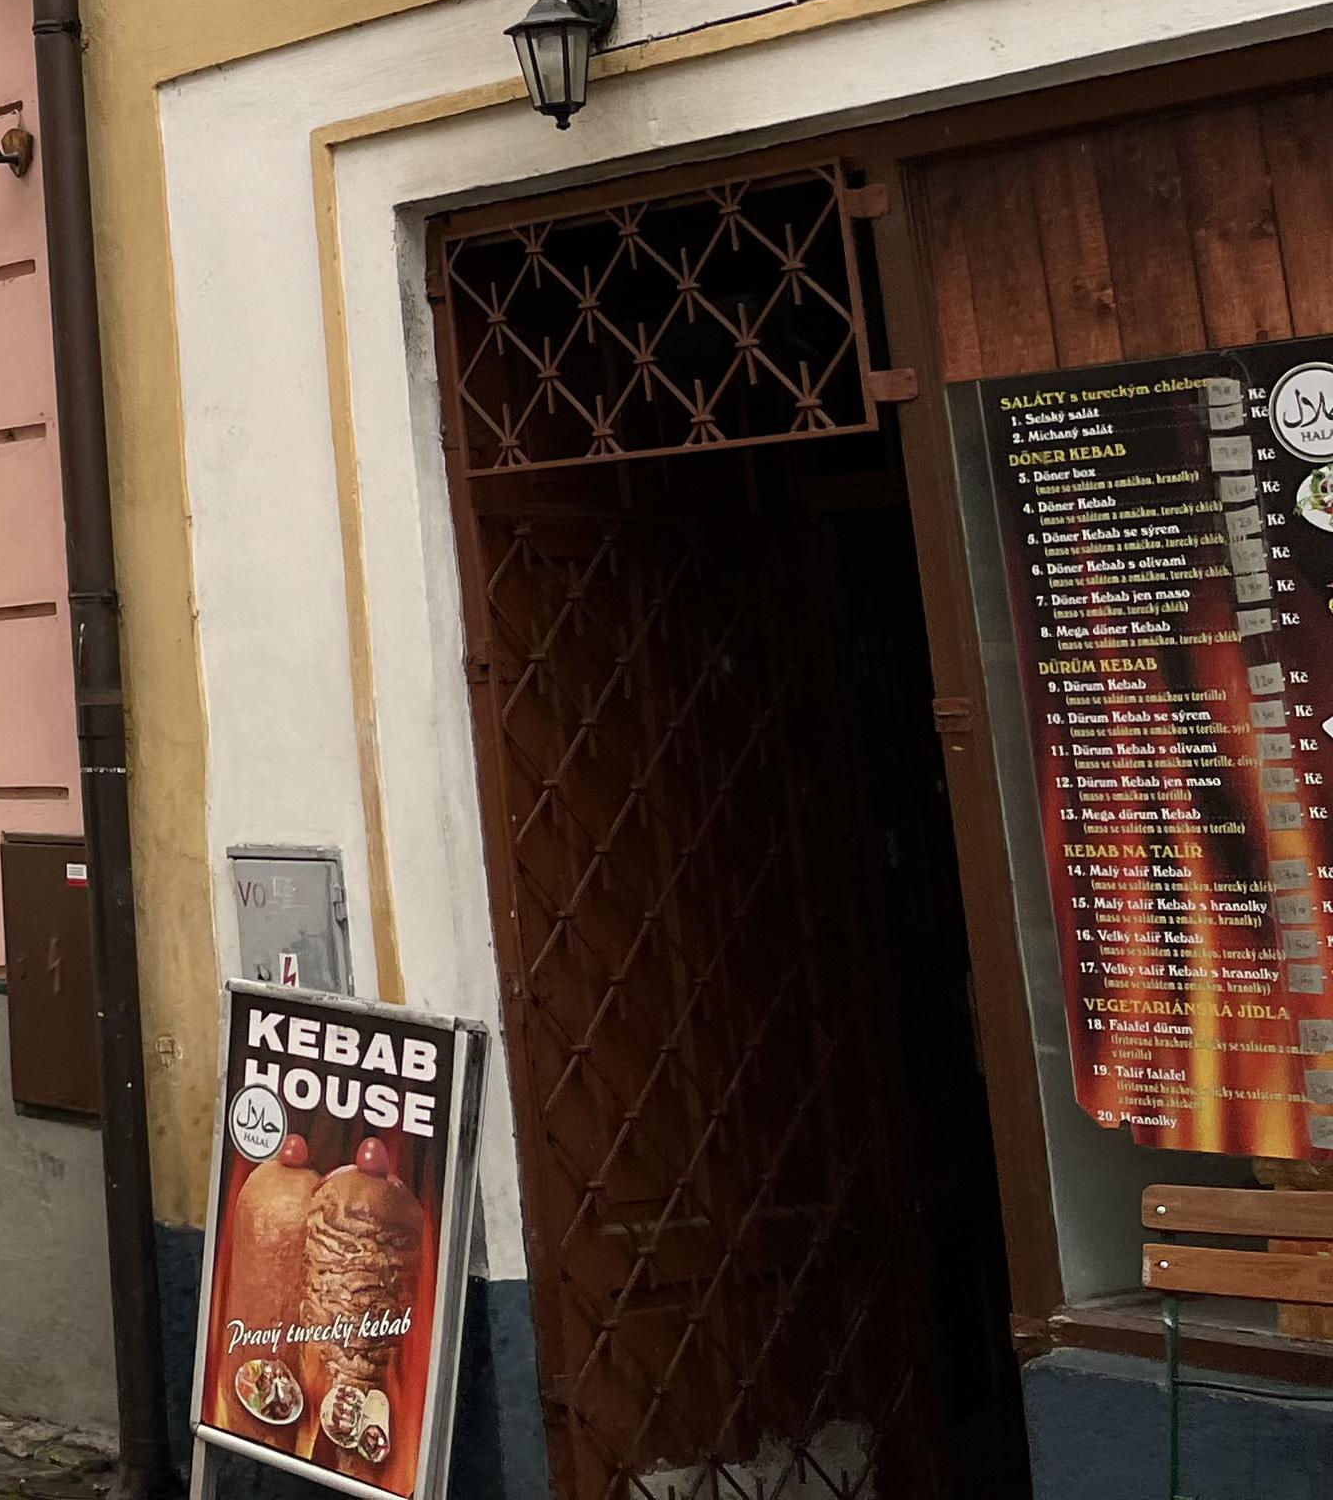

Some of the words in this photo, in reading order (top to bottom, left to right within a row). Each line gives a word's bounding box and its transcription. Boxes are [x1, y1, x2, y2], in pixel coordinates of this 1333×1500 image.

[1000, 391, 1065, 411] SALÁTY
[1070, 394, 1078, 403] s
[1082, 384, 1150, 401] tureckým
[1248, 388, 1267, 400] Kč
[1012, 416, 1022, 426] 1.
[1069, 408, 1100, 419] salát
[1251, 406, 1269, 418] Kč
[1013, 432, 1024, 444] 2.
[1082, 424, 1113, 437] salát
[1301, 429, 1333, 442] HALA
[1009, 450, 1066, 466] DÖNER
[1070, 444, 1127, 460] KEBAB
[1019, 473, 1030, 484] 3.
[1034, 469, 1070, 483] Döner
[1073, 468, 1096, 480] box
[1257, 448, 1276, 461] Kč
[1023, 504, 1034, 514] 4.
[1038, 500, 1074, 513] Döner
[1078, 496, 1116, 510] Kebab
[1262, 480, 1281, 493] Kč
[1028, 534, 1039, 545] 5.
[1043, 531, 1079, 544] Döner
[1082, 527, 1121, 540] Kebab
[1124, 529, 1137, 538] se
[1141, 524, 1180, 540] sýrem
[1267, 513, 1285, 526] Kč
[1032, 565, 1043, 575] 6.
[1047, 562, 1083, 575] Döner
[1087, 559, 1126, 572] Kebab
[1128, 560, 1136, 569] s
[1139, 554, 1186, 568] olivami
[1272, 546, 1291, 558] Kč
[1036, 596, 1048, 607] 7.
[1051, 593, 1088, 606] Döner
[1091, 590, 1130, 604] Kebab
[1132, 591, 1152, 604] jen
[1156, 589, 1190, 599] maso
[1277, 579, 1296, 591] Kč
[1041, 627, 1053, 638] 8.
[1056, 626, 1089, 639] Mega
[1093, 623, 1128, 635] döner
[1131, 621, 1170, 634] Kebab
[1281, 613, 1301, 625] Kč
[1038, 660, 1096, 675] DÜRÜM
[1100, 658, 1158, 673] KEBAB
[1048, 681, 1060, 693] 9.
[1064, 679, 1105, 692] Dürum
[1108, 678, 1146, 690] Kebab
[1289, 671, 1309, 683] Kč
[1047, 714, 1064, 725] 10.
[1068, 712, 1109, 724] Dürum
[1113, 711, 1151, 722] Kebab
[1155, 712, 1168, 721] se
[1172, 710, 1211, 724] sýrem
[1295, 705, 1313, 717] Kč
[1051, 745, 1069, 756] 11.
[1072, 744, 1113, 755] Dürum
[1117, 743, 1155, 755] Kebab
[1159, 745, 1166, 753] s
[1170, 743, 1217, 754] olivami
[1299, 738, 1318, 751] Kč
[1056, 778, 1073, 788] 12.
[1077, 776, 1118, 787] Dürum
[1121, 775, 1160, 787] Kebab
[1163, 777, 1182, 789] jen
[1186, 776, 1221, 786] maso
[1304, 773, 1323, 784] Kč
[1061, 809, 1078, 819] 13.
[1081, 809, 1115, 821] Mega
[1119, 808, 1159, 819] dürum
[1162, 808, 1201, 820] Kebab
[1309, 806, 1328, 819] Kč
[1064, 844, 1119, 858] KEBAB
[1123, 846, 1147, 858] NA
[1067, 866, 1085, 876] 14.
[1089, 865, 1119, 878] Malý
[1152, 865, 1192, 878] Kebab
[238, 880, 266, 908] VO
[1072, 898, 1089, 908] 15.
[1094, 897, 1123, 911] Malý
[1157, 898, 1196, 911] Kebab
[1199, 901, 1207, 911] s
[1211, 899, 1267, 914] hranolky
[1076, 930, 1094, 941] 16.
[1097, 930, 1130, 943] Velký
[1164, 931, 1204, 944] Kebab
[1080, 963, 1098, 974] 17.
[1101, 963, 1135, 976] Velký
[1168, 965, 1207, 978] Kebab
[1211, 968, 1219, 978] s
[1222, 967, 1280, 982] hranolky
[1083, 997, 1233, 1018] VEGETARIÁNÁ
[1087, 1019, 1106, 1030] 18.
[1109, 1020, 1150, 1032] Falafel
[1153, 1020, 1194, 1034] dürum
[248, 1009, 437, 1082] KEBAB
[1093, 1065, 1111, 1076] 19.
[244, 1059, 436, 1137] HOUSE
[1097, 1110, 1117, 1122] 20.
[1120, 1112, 1178, 1128] Hranolky
[243, 1132, 269, 1148] HALAL
[227, 1320, 283, 1353] Pravý
[287, 1314, 354, 1347] turecký
[358, 1307, 412, 1338] kebab
